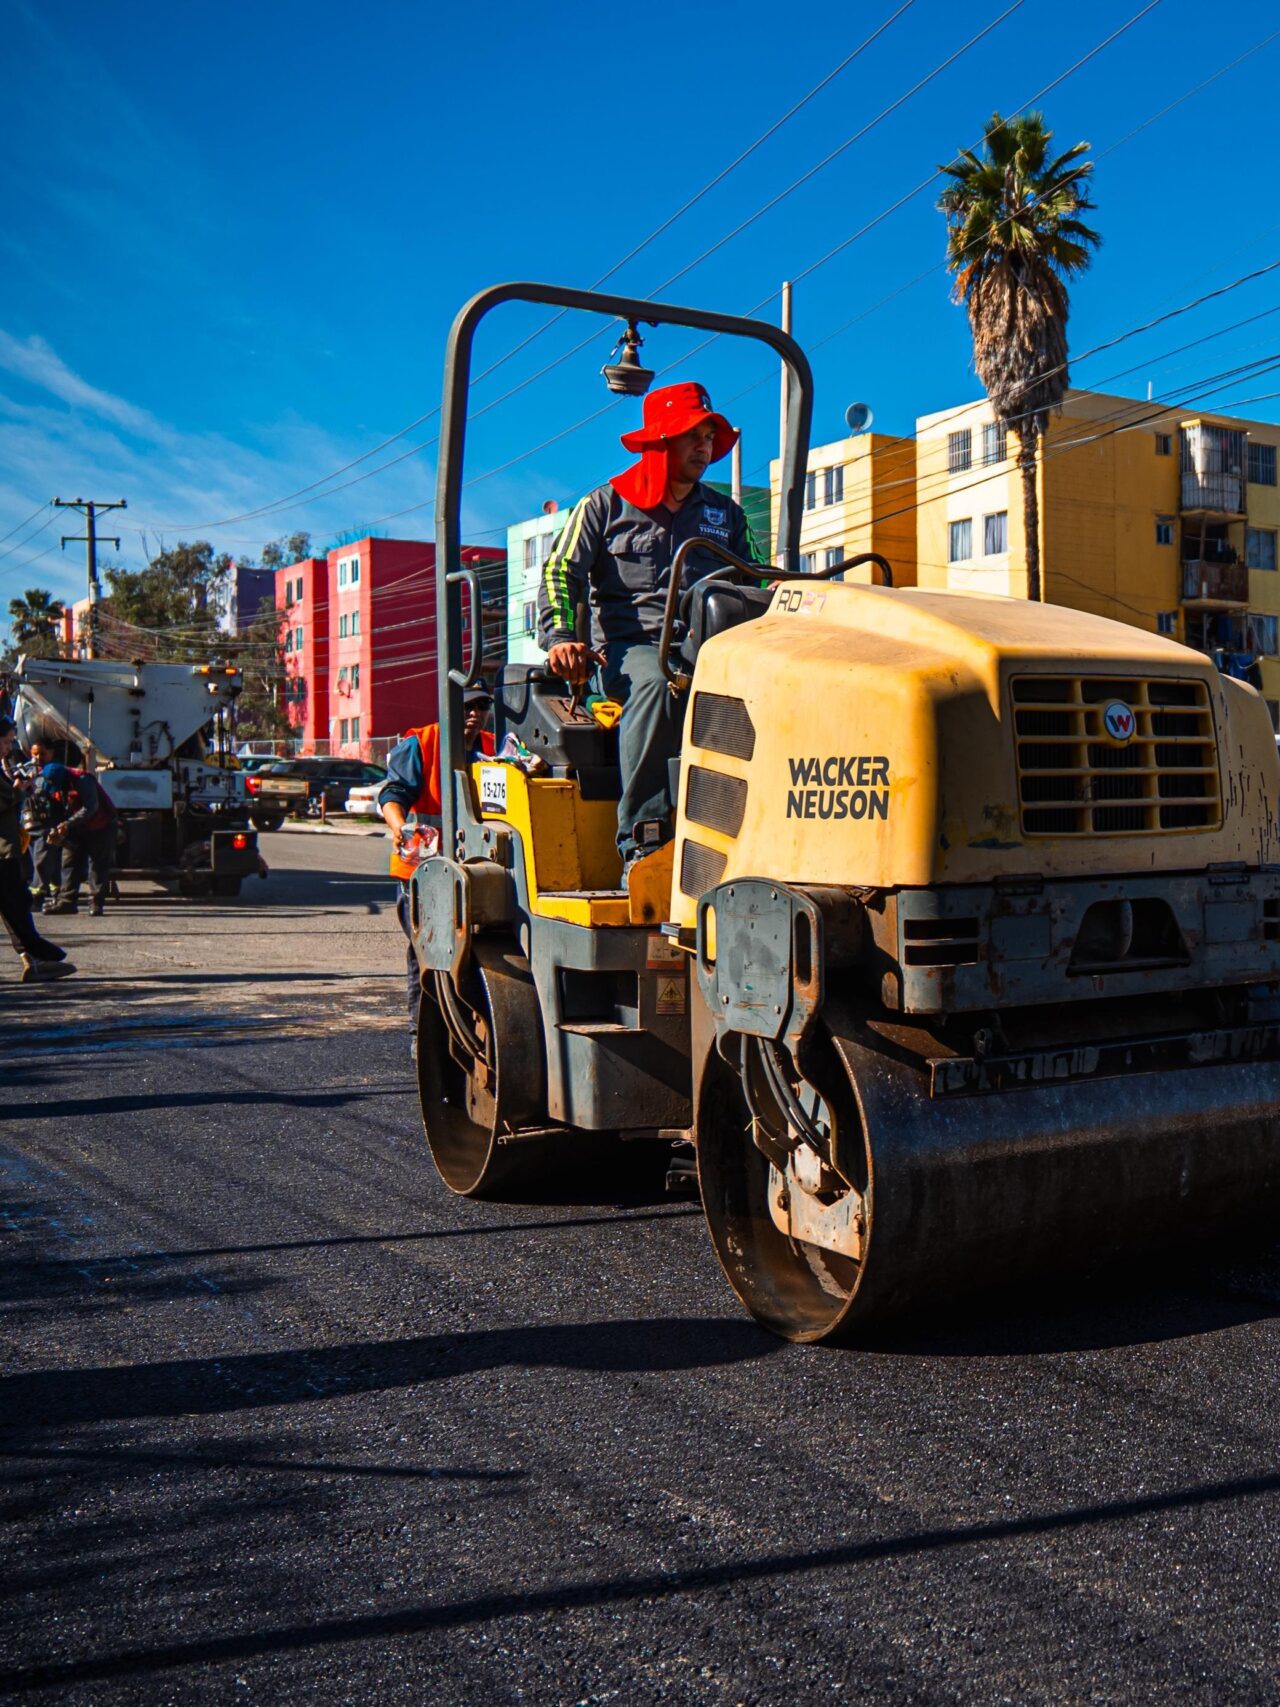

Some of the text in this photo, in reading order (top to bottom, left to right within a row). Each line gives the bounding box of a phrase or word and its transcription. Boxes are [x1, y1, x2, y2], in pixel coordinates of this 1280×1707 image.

[788, 756, 890, 787] WACKER
[483, 782, 505, 799] 15-276
[786, 789, 890, 820] NEUSON
